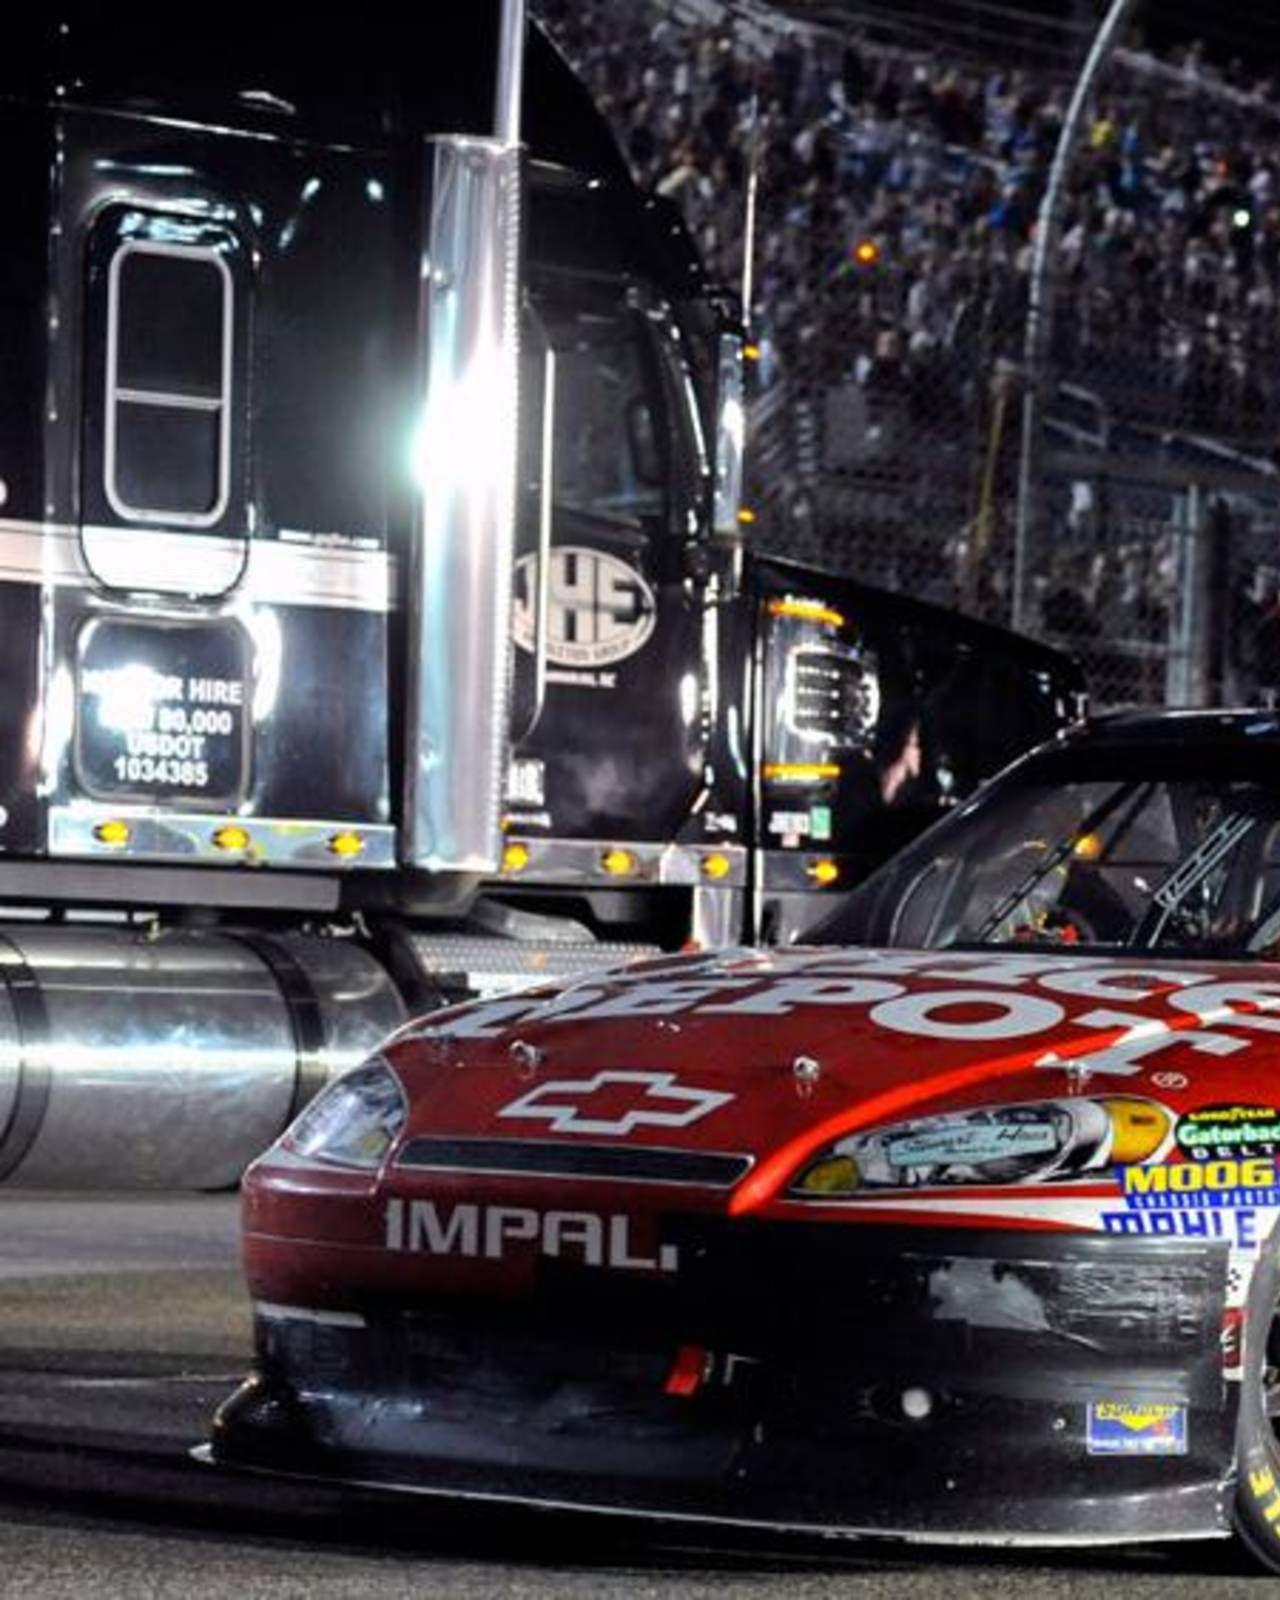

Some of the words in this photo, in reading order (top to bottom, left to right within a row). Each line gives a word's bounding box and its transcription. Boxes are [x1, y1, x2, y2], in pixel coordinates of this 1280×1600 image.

[189, 678, 244, 705] HIRE
[1124, 1159, 1276, 1194] MOOG
[386, 1200, 678, 1271] IMPAL
